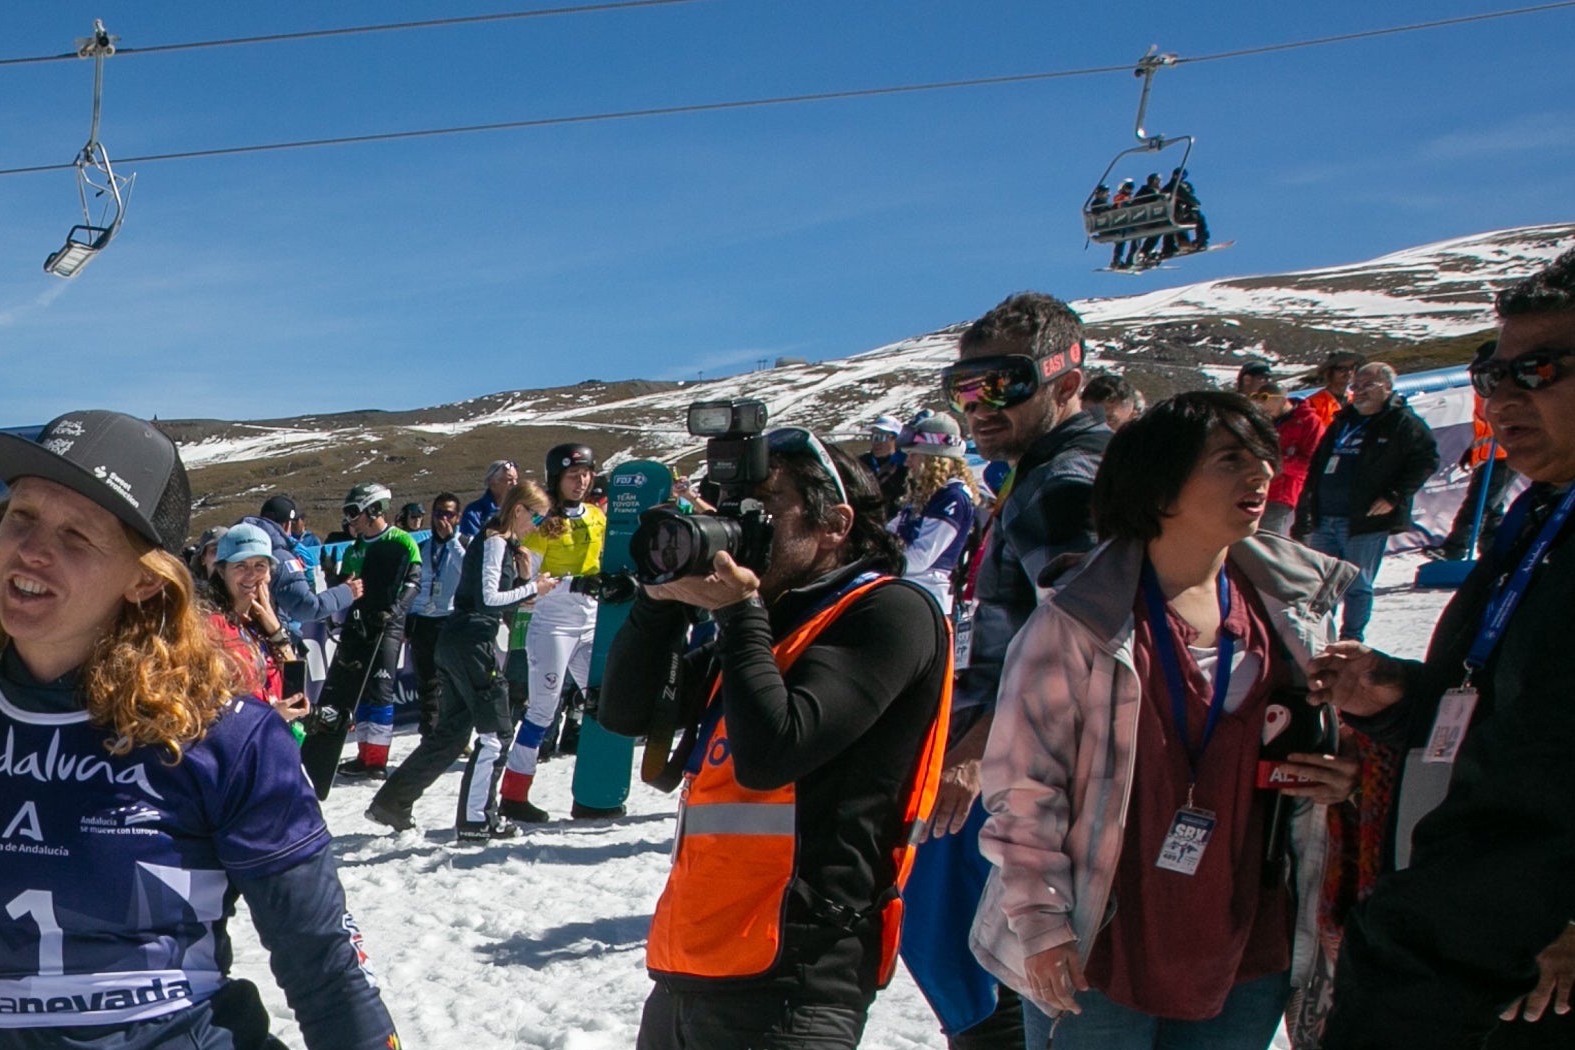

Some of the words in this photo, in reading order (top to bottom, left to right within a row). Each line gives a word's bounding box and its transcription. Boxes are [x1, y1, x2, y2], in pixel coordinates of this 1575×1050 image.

[1042, 351, 1065, 377] EASY
[109, 471, 132, 491] Sweet
[105, 477, 140, 508] Protection
[944, 501, 957, 515] 4
[662, 685, 677, 700] Z
[5, 841, 18, 852] de
[18, 843, 69, 857] Andalucía
[5, 889, 64, 975] 1
